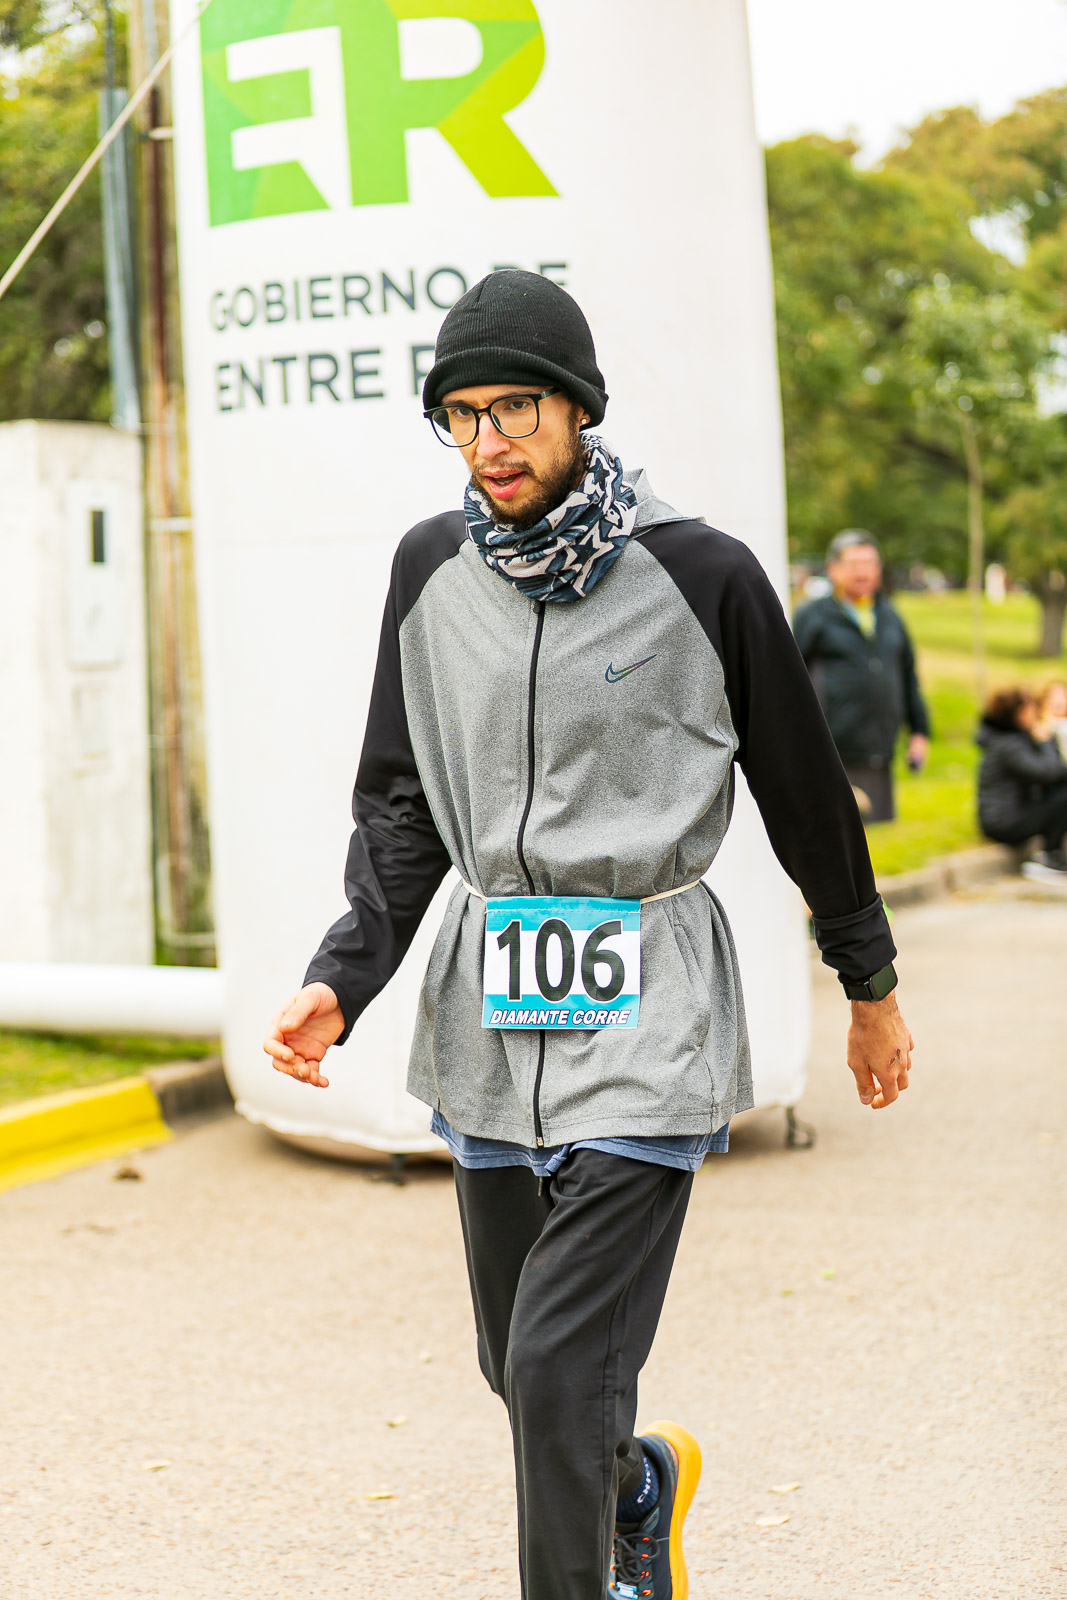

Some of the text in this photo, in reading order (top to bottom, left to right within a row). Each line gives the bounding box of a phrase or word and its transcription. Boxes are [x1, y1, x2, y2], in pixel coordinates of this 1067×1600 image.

[199, 0, 561, 227] ER
[211, 267, 467, 332] GOBIERNO
[218, 348, 385, 412] ENTRE
[496, 918, 626, 1003] 106
[489, 1009, 631, 1025] DIAMANTE CORRE
